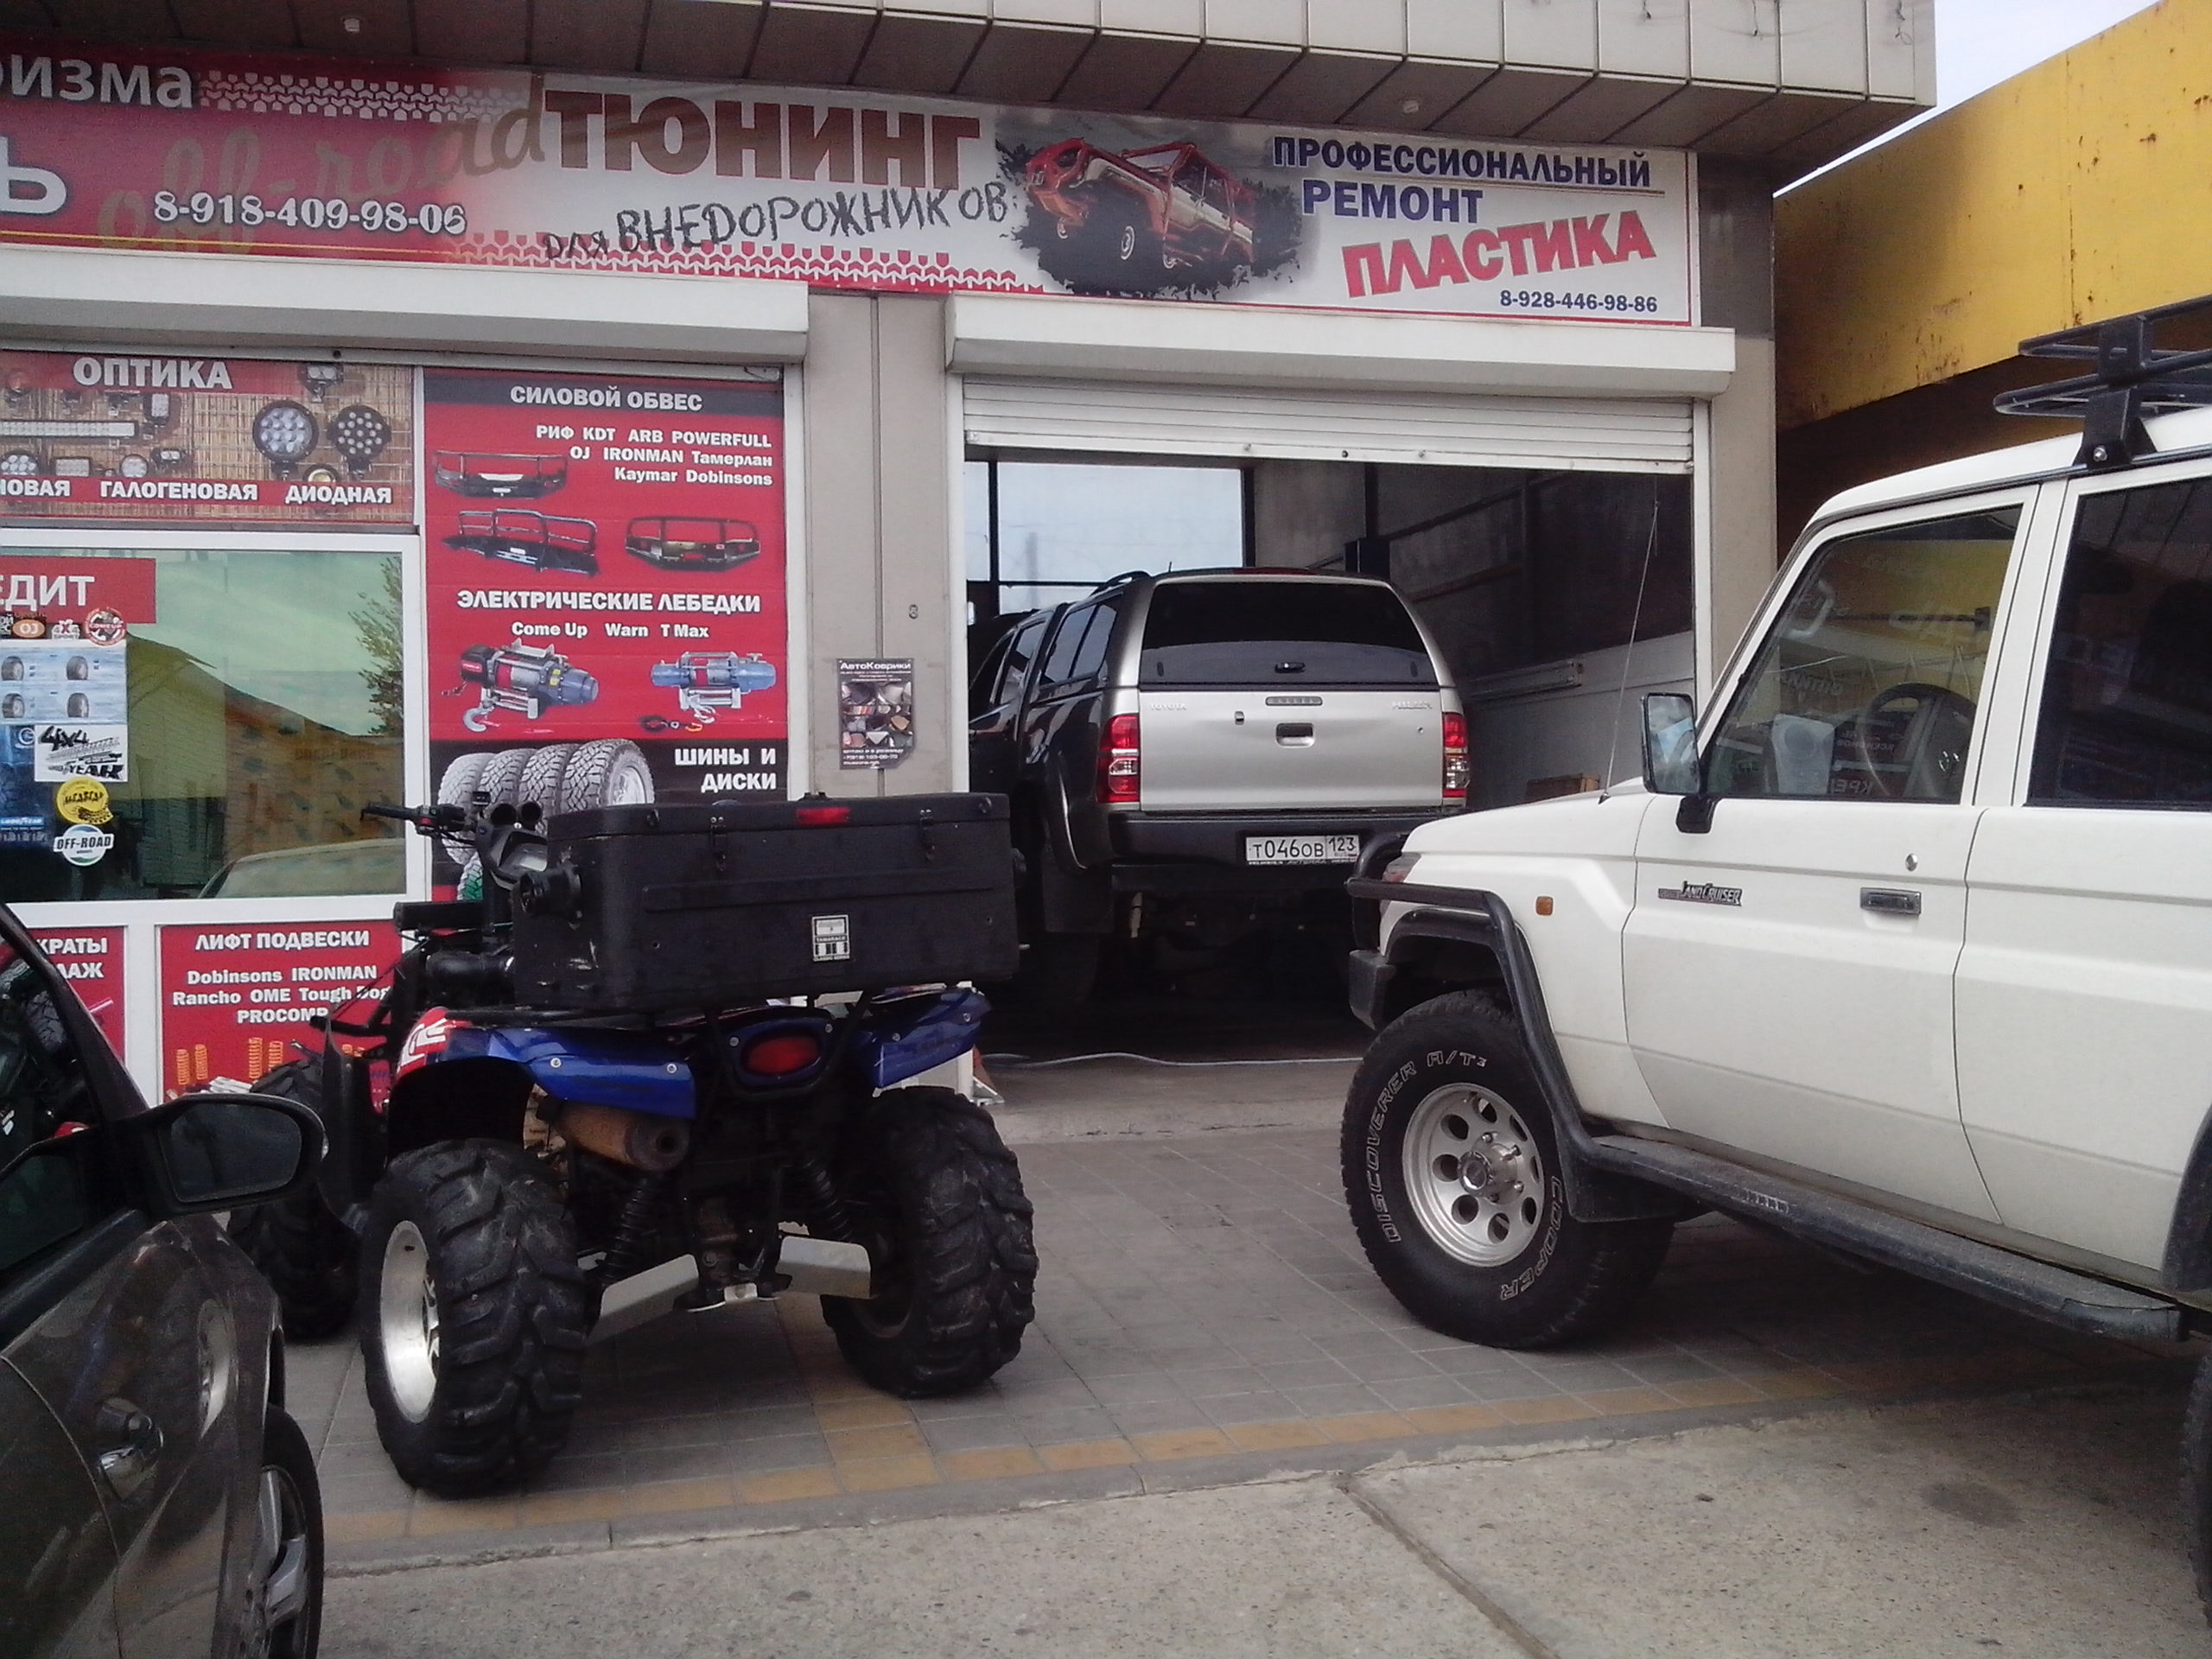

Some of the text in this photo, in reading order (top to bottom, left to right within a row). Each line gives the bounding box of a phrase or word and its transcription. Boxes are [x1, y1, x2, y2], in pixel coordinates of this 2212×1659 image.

[0, 53, 194, 108] изма
[544, 90, 981, 190] ТЮНИНГ
[1273, 136, 1651, 188] ПРОФЕССИОНАЛЬНЫЙ
[153, 191, 467, 235] 8-918-409-98-06
[1303, 180, 1484, 224] РЕМОНТ
[616, 181, 1008, 253] ВНЕДОРОЖНИКОВ
[1341, 210, 1657, 299] ПЛАСТИКА
[1499, 289, 1658, 313] 8-928-446-98-86
[73, 357, 233, 390] ОПТИКА
[510, 385, 702, 411] СИЛОВОЙ ОБВЕС
[536, 425, 772, 448] РИФ KDT ARB POWERFULL
[569, 447, 773, 467] OJ IRONMAN Тамерлан
[614, 467, 773, 486] Kaymar Dobinsons
[99, 480, 258, 500] ГАЛОГЕНОВАЯ
[284, 485, 392, 505] ДИОДНАЯ
[457, 590, 760, 615] ЭЛЕКТРИЧЕСКИЕ ЛЕБЕДКИ
[512, 621, 709, 639] Come Up Warn T Max
[840, 662, 912, 671] АвтоКоврики
[675, 747, 776, 766] ШИНЫ И
[701, 773, 777, 792] ДИСКИ
[57, 836, 111, 849] OFF-ROAD
[1328, 836, 1356, 852] 123
[195, 931, 370, 950] ЛИФТ ПОДВЕСКИ
[187, 964, 378, 986] Dobinsons IRONMAN
[173, 989, 241, 1006] Rancho
[250, 986, 292, 1003] OME
[299, 986, 352, 1003] Tough
[1366, 1060, 1417, 1244] DISCOVERER
[1500, 1175, 1565, 1300] COOPER
